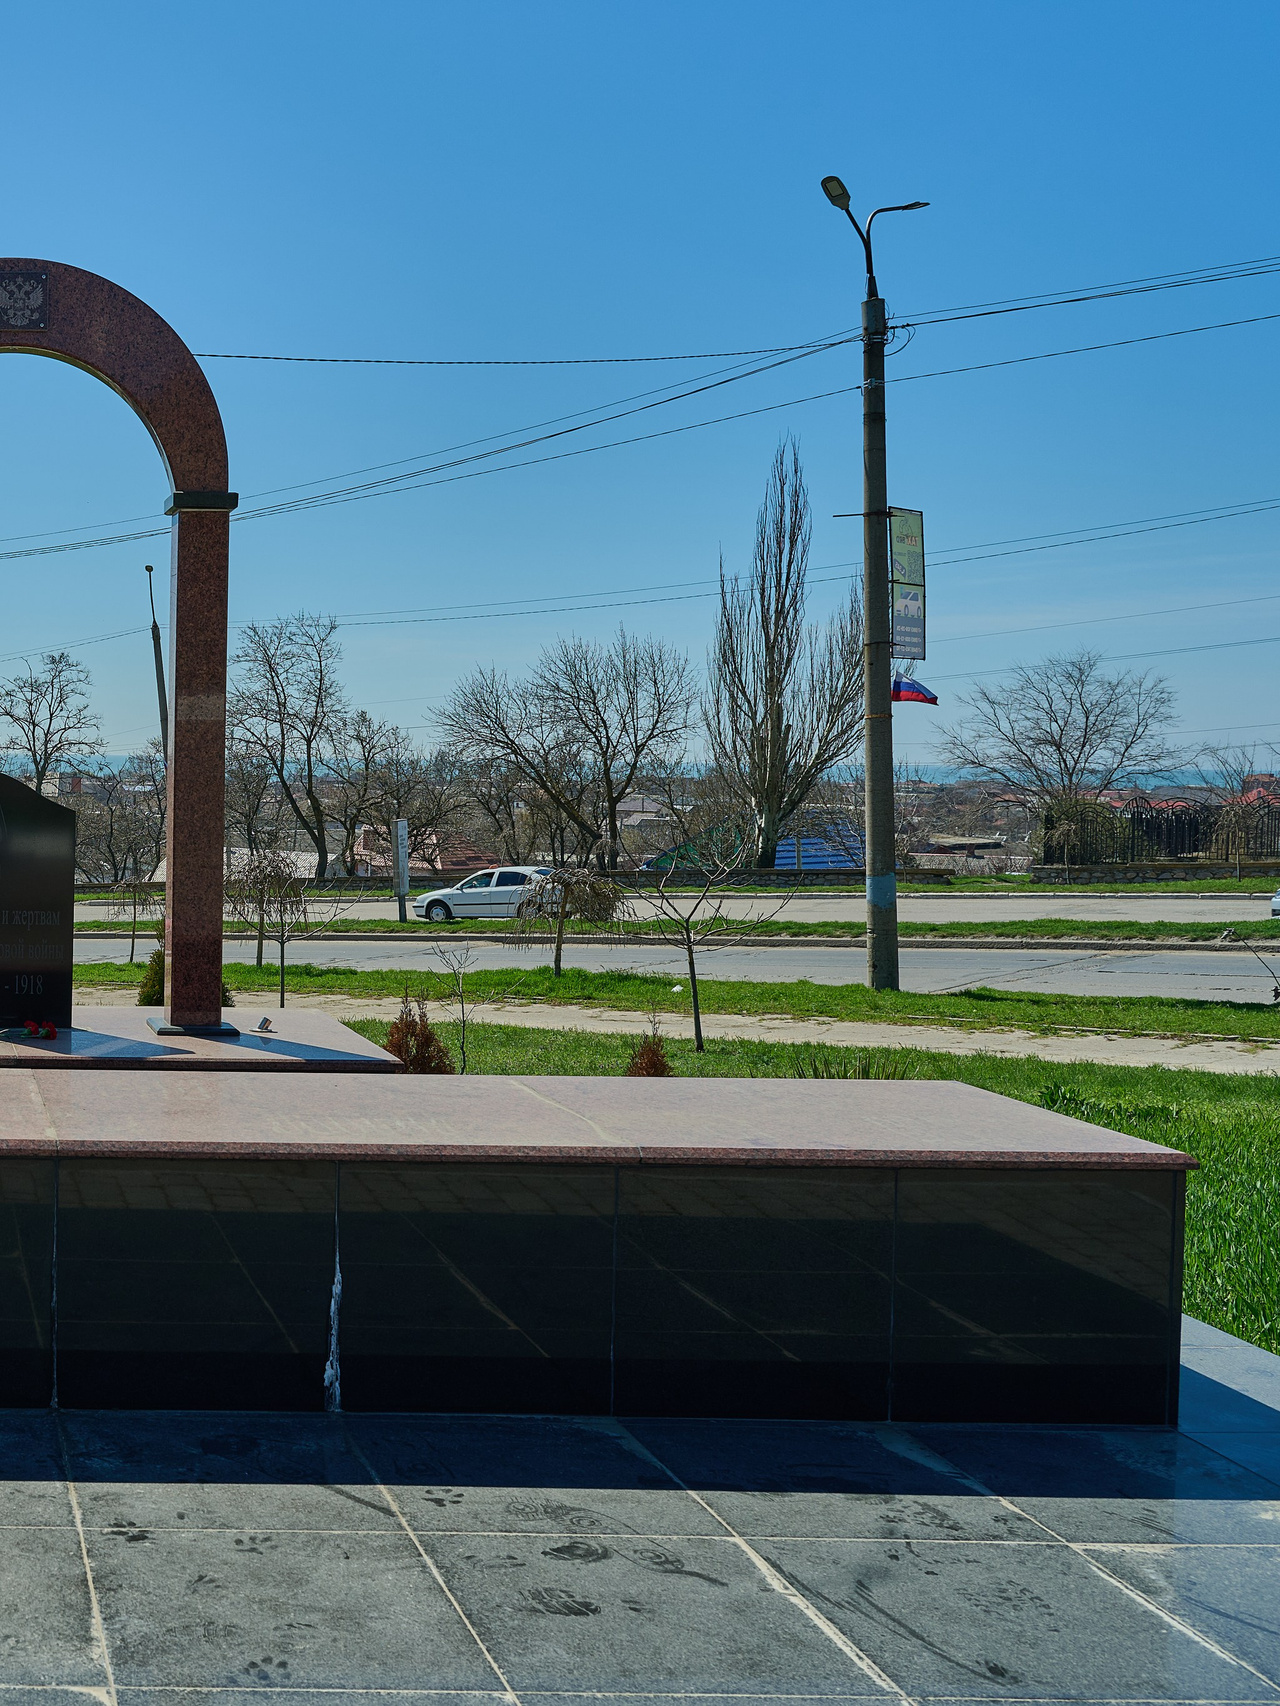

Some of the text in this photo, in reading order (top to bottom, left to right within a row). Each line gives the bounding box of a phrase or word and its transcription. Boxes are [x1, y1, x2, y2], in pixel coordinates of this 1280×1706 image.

[2, 910, 9, 925] и
[12, 910, 61, 931] жертвам
[29, 938, 65, 960] войны
[15, 974, 43, 995] 1918
